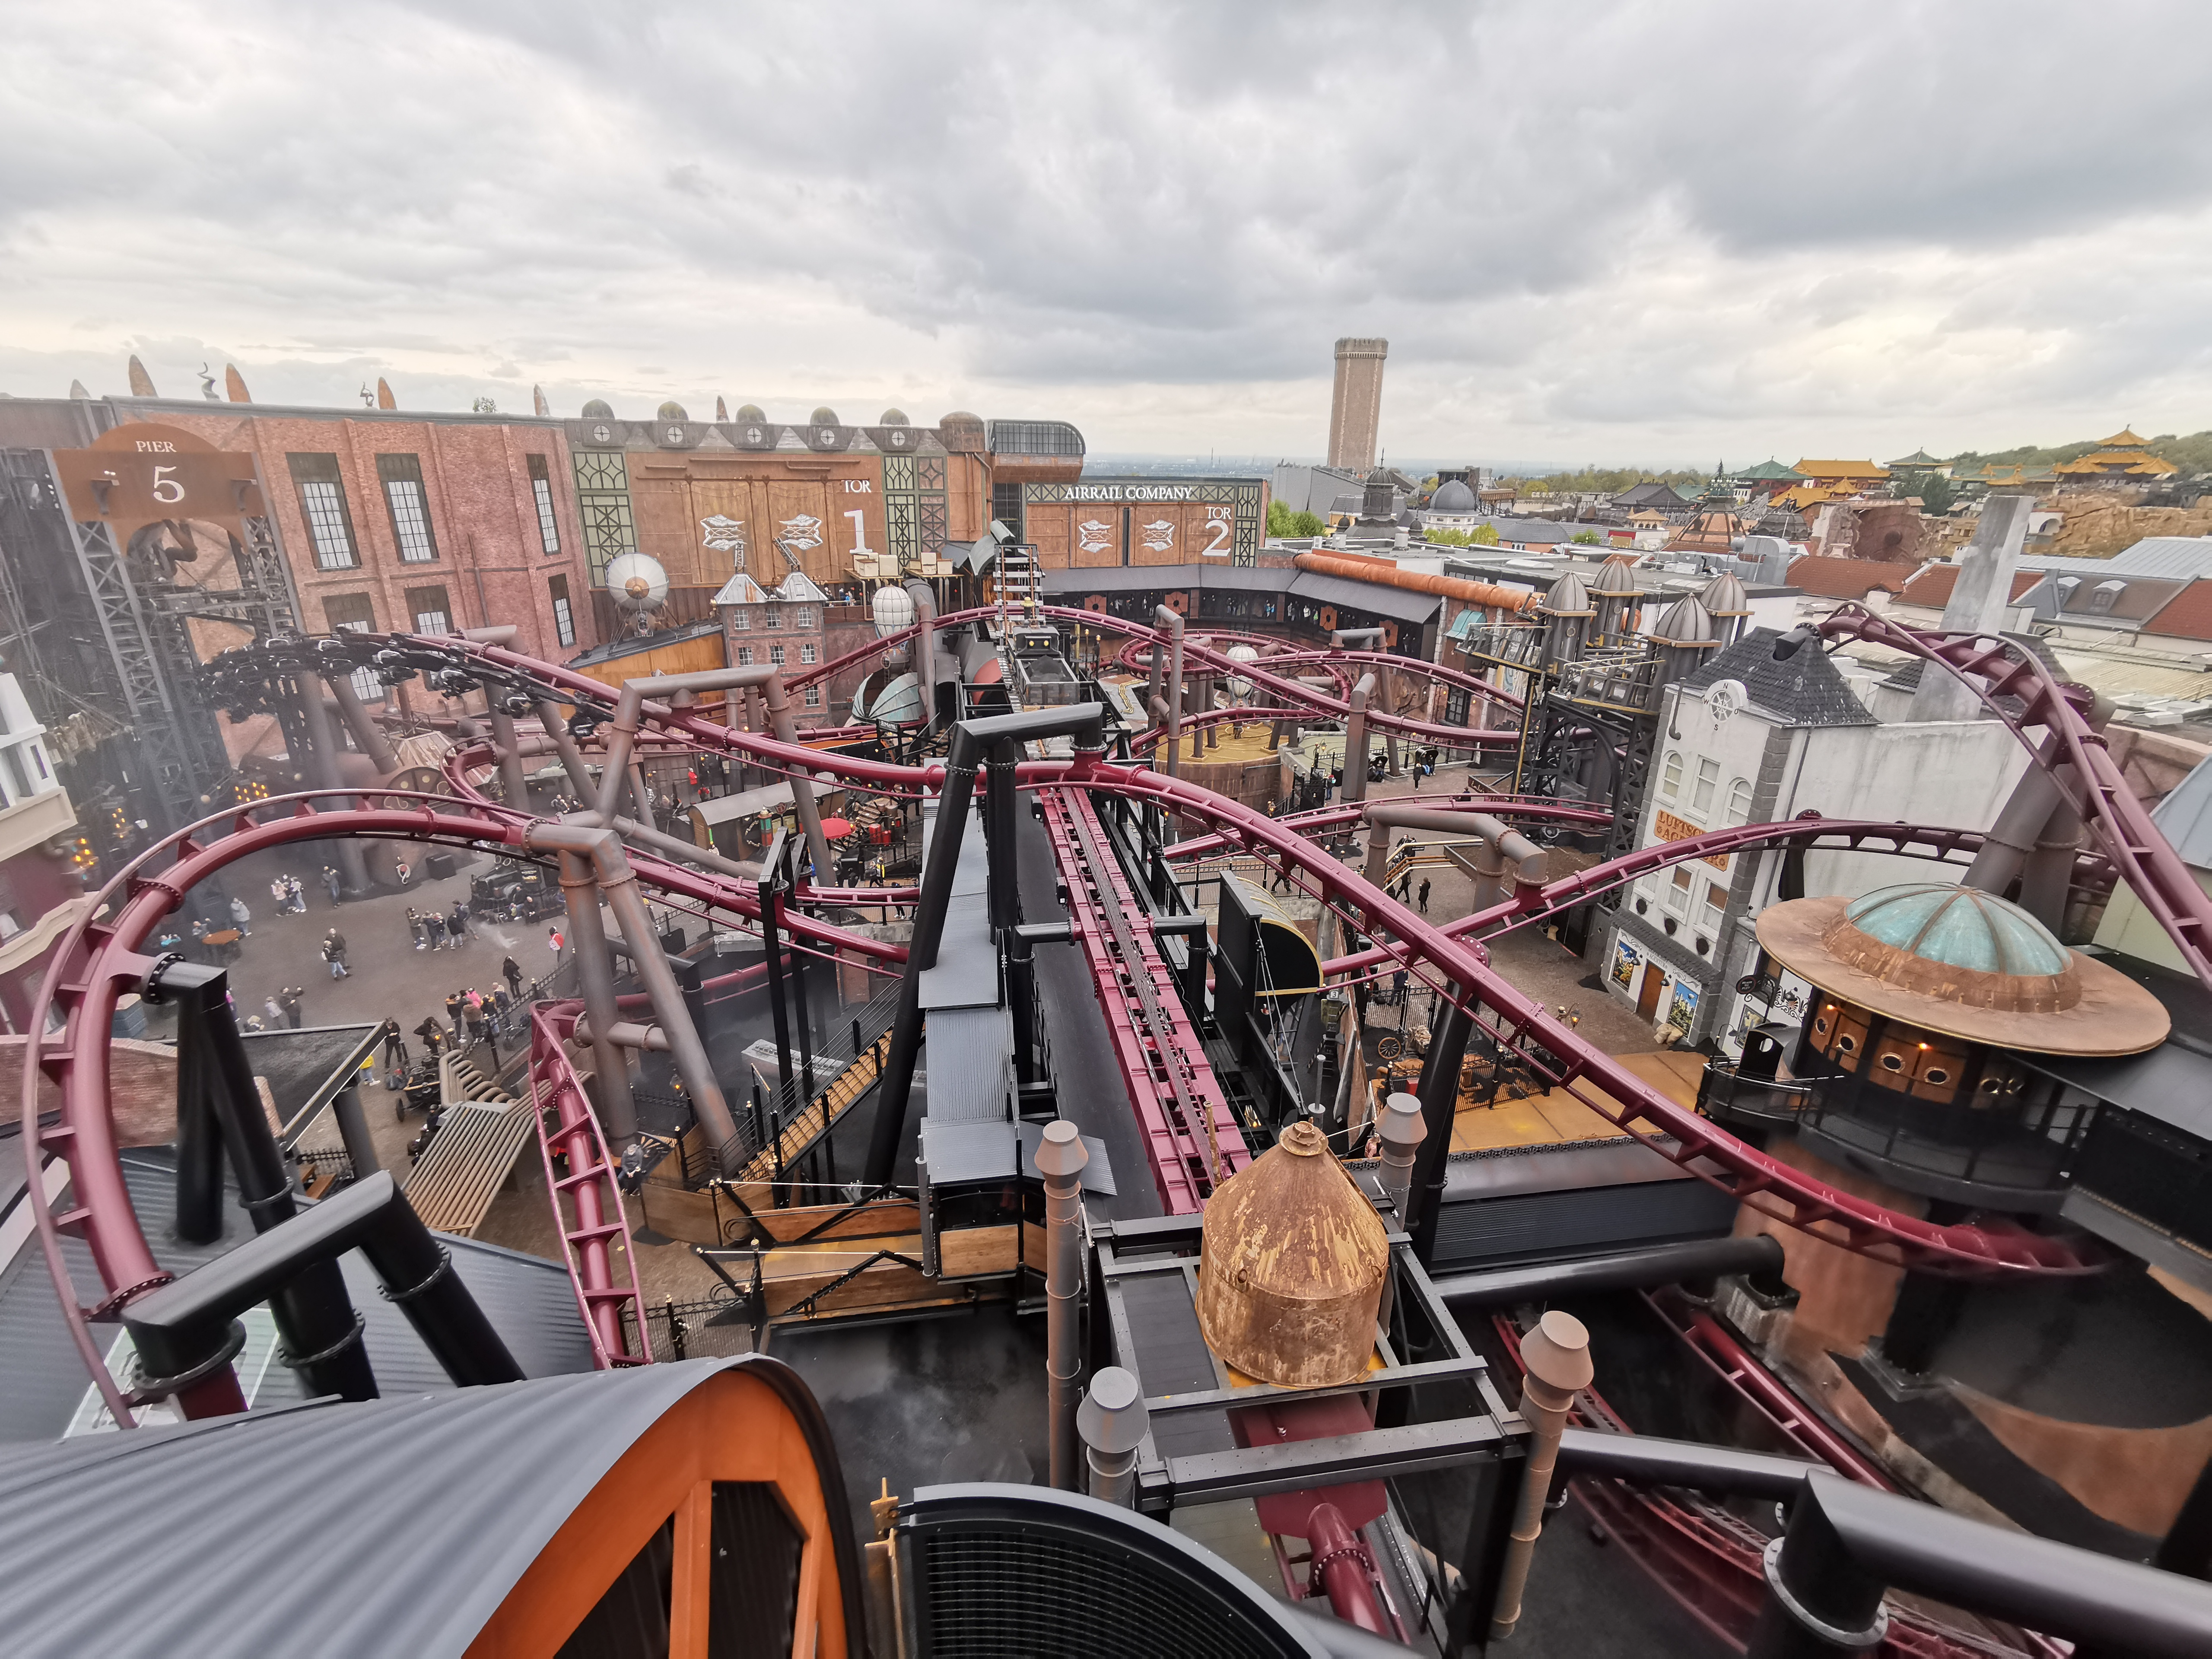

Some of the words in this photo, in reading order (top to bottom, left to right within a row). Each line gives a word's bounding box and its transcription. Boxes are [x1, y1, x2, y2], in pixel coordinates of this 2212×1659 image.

[136, 441, 177, 452] PIER
[153, 466, 185, 502] 5
[841, 480, 871, 493] TOR
[1064, 487, 1123, 499] AIRRAIL
[1126, 487, 1193, 499] COMPANY
[1205, 506, 1232, 520] TOR
[844, 509, 873, 554] 1
[1202, 519, 1231, 556] 2
